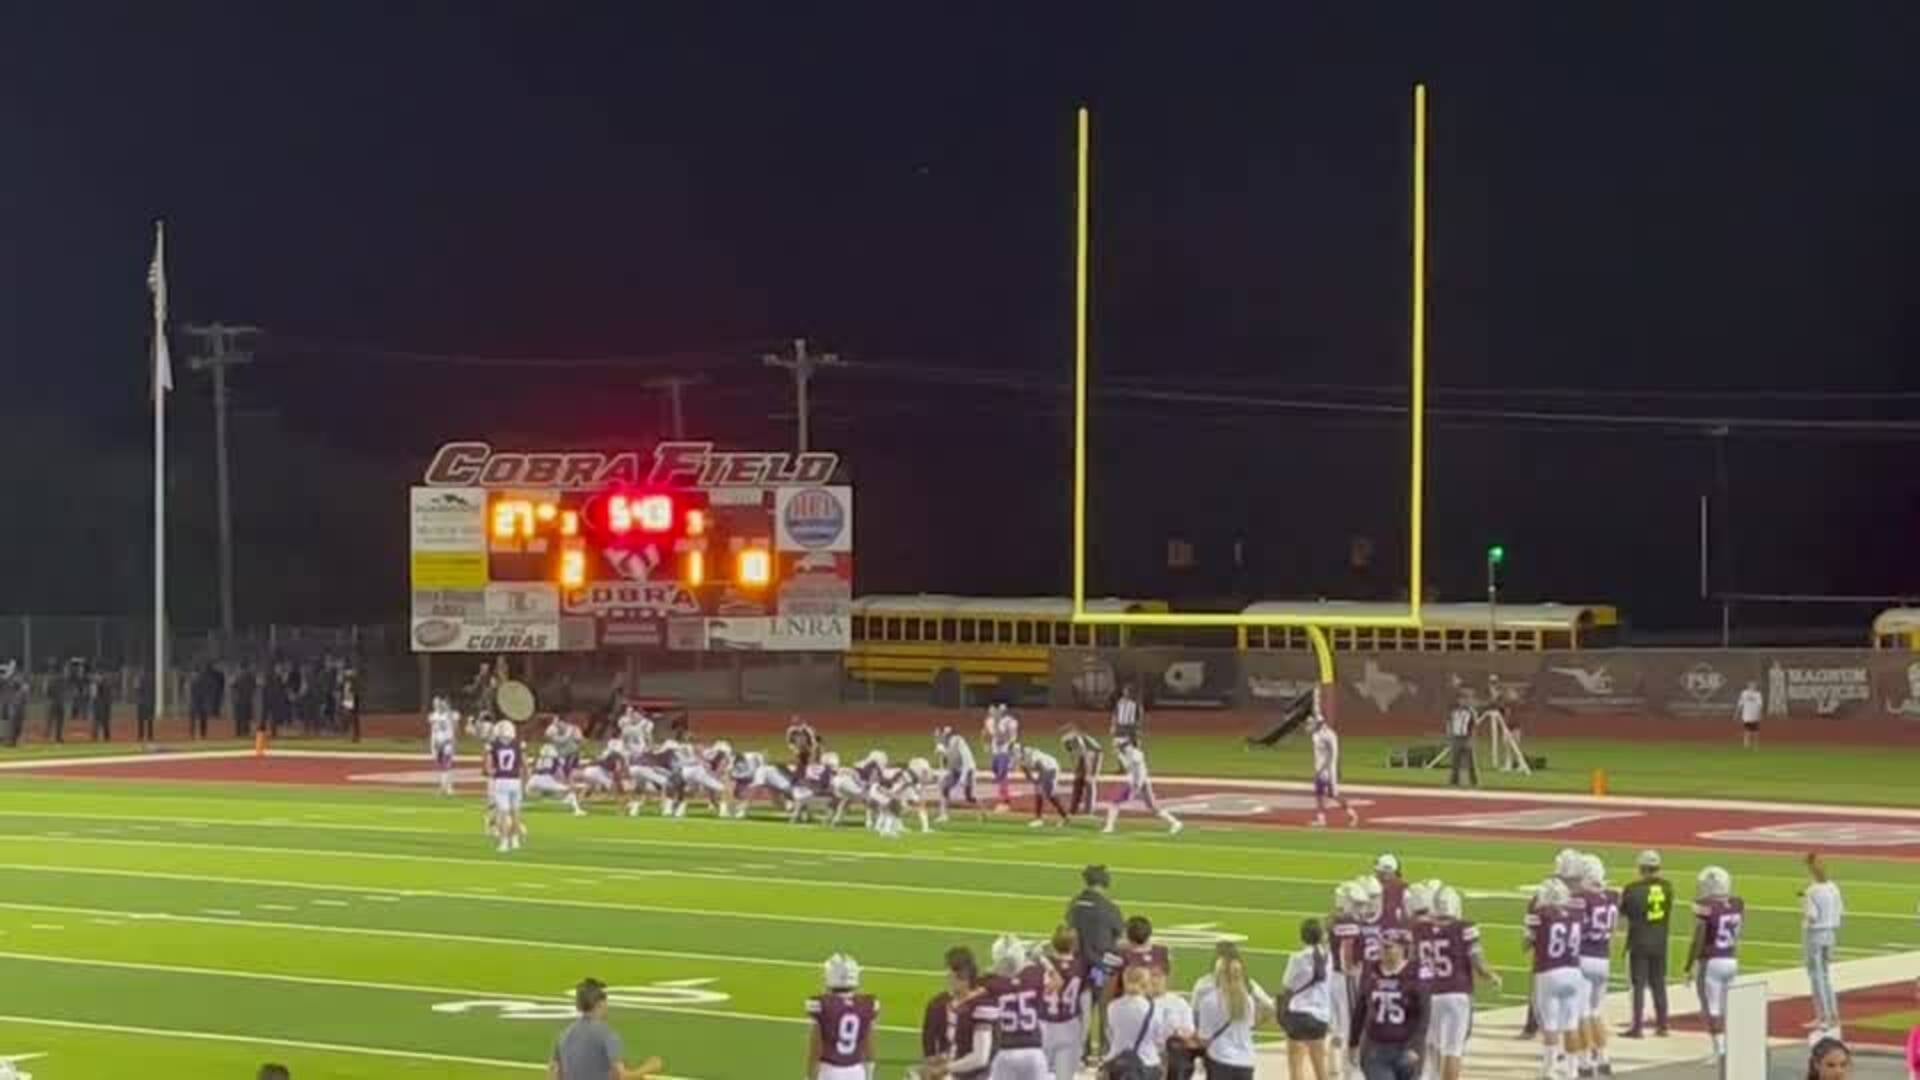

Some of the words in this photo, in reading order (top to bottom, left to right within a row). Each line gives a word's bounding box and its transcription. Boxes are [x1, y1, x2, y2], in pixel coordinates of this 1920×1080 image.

[425, 441, 640, 489] COBRA
[649, 441, 839, 487] FIELD
[1548, 922, 1582, 959] 64
[998, 990, 1039, 1033] 55
[1371, 990, 1407, 1024] 75
[836, 1013, 861, 1056] 9
